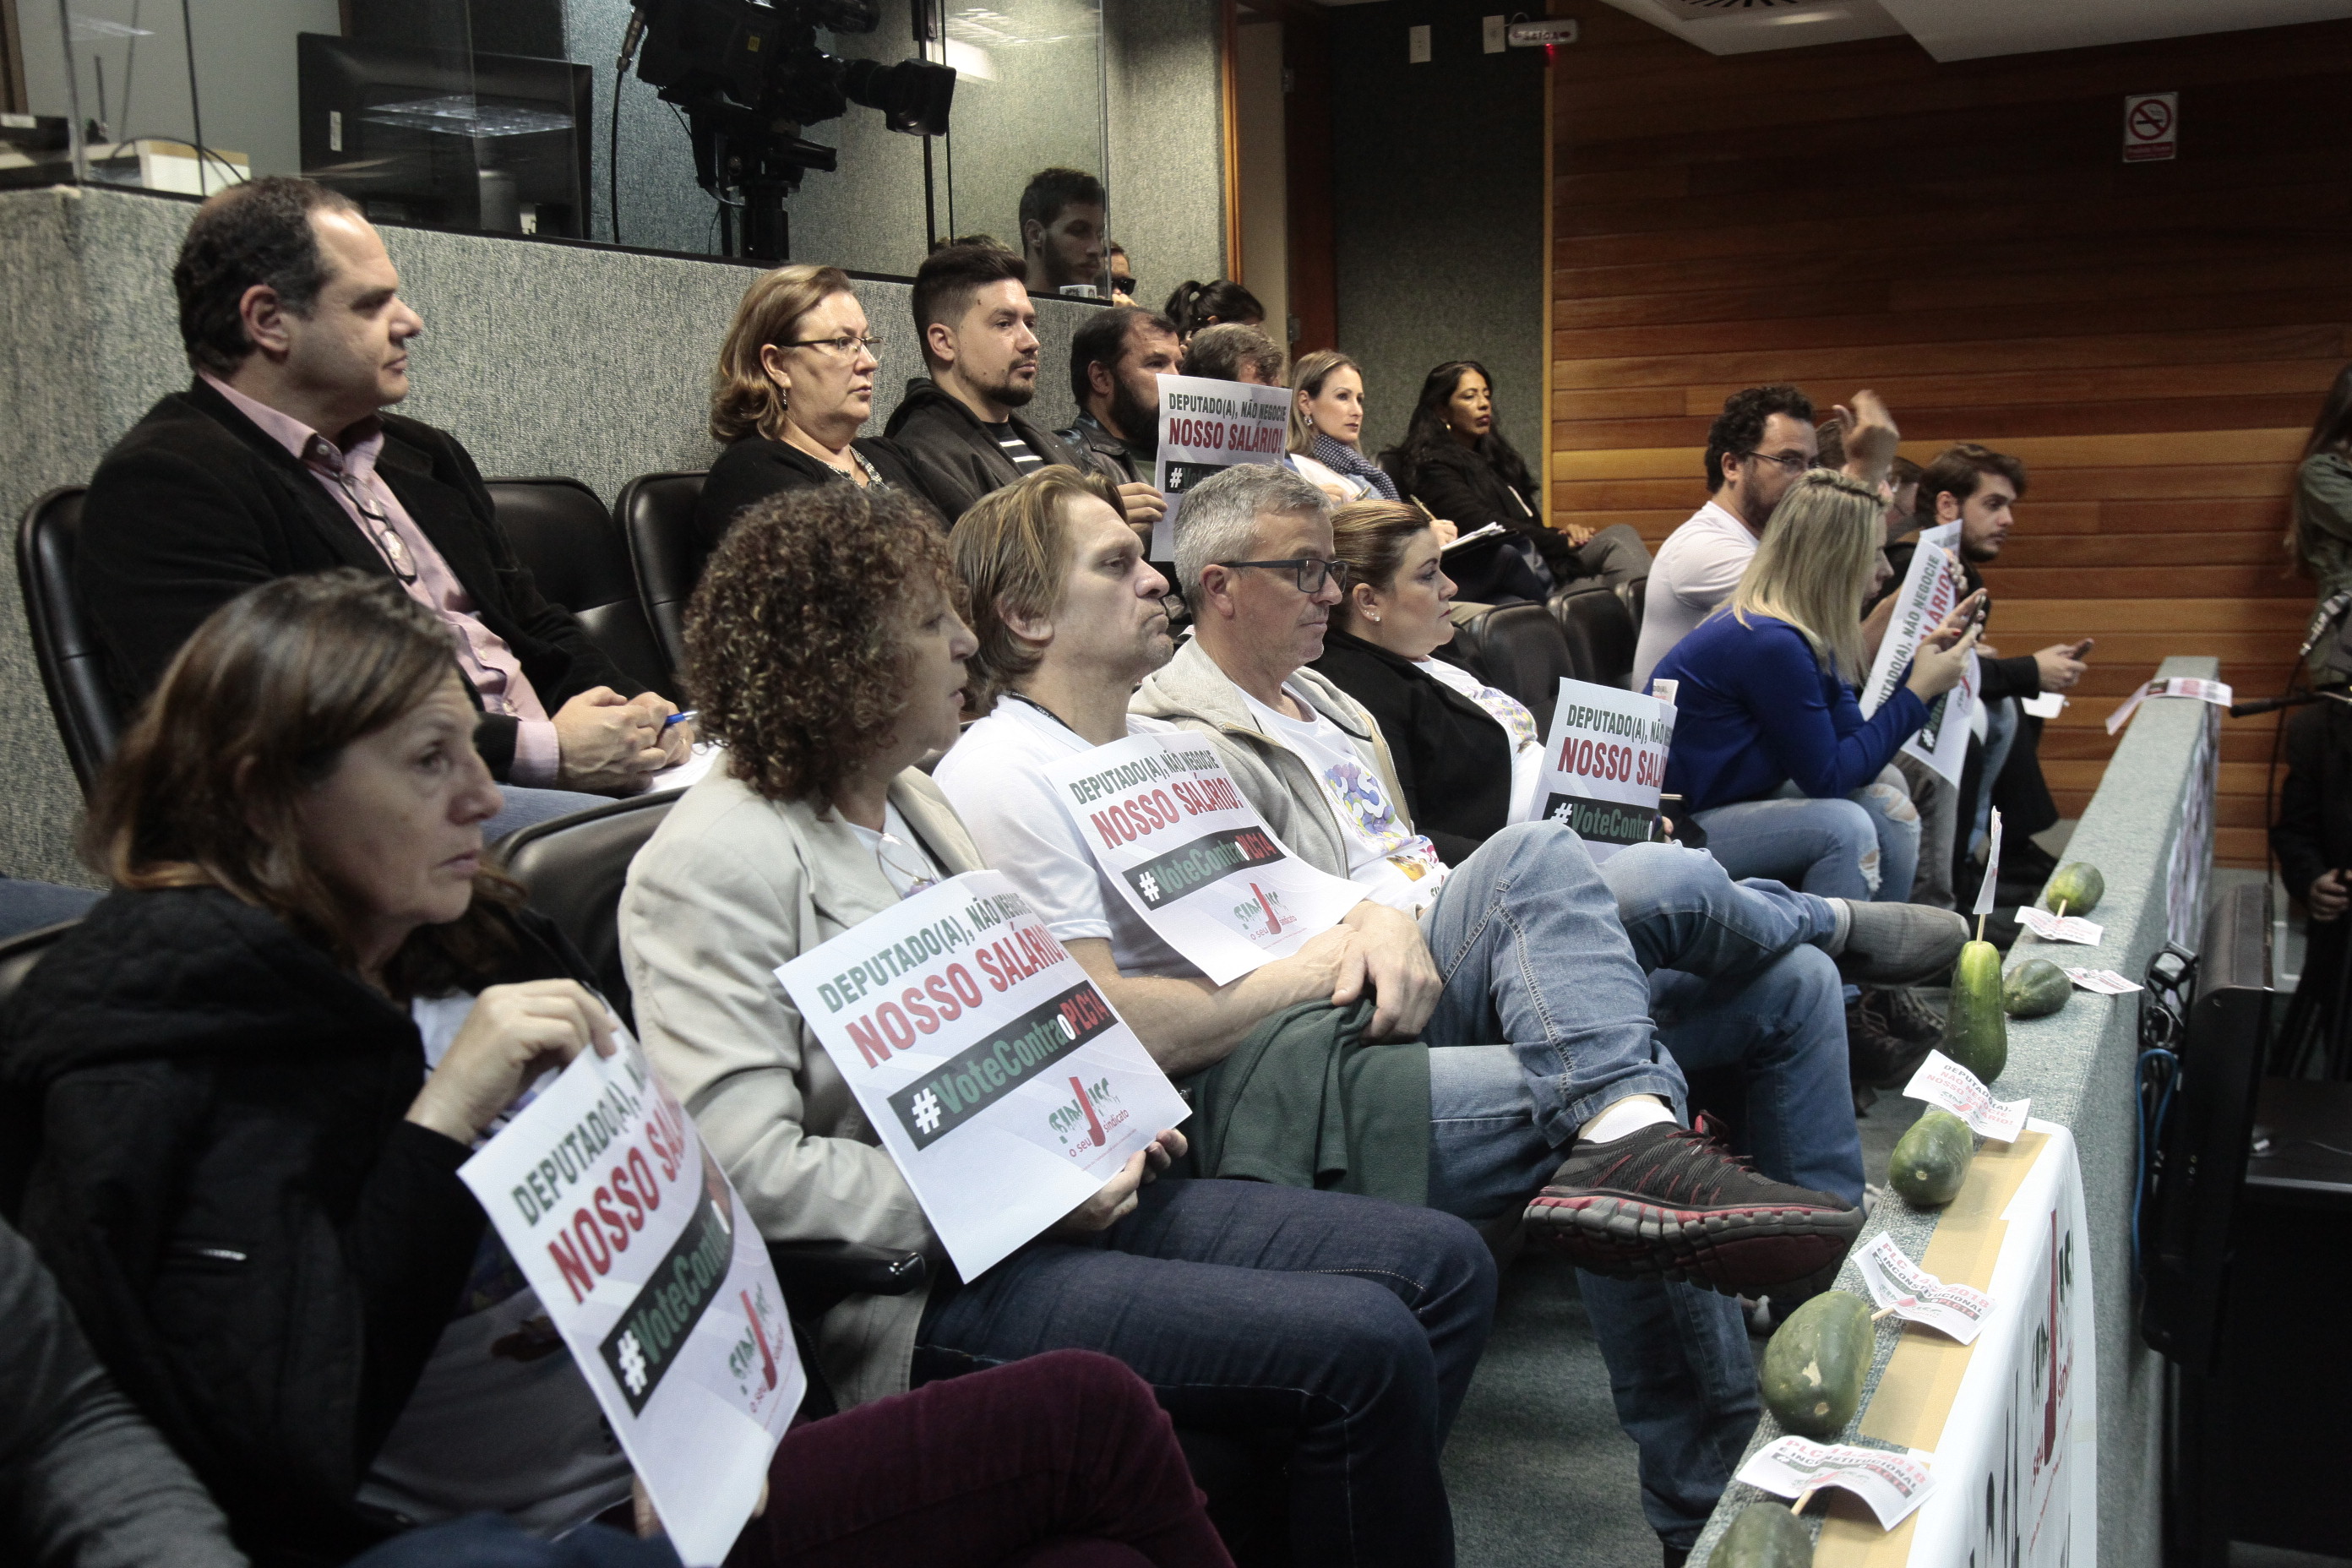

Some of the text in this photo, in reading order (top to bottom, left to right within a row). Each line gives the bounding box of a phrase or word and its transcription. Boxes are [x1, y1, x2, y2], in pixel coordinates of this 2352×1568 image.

[1169, 393, 1287, 422] DEPUTADO(A), NÃO NEGOCIE
[1169, 417, 1283, 455] NOSSO SALÁRIO!
[1903, 611, 1920, 638] NÃO
[1912, 553, 1941, 610] NEGOCIE
[1566, 704, 1647, 744] DEPUTADO(A),
[1650, 718, 1664, 745] NÃO
[1069, 749, 1220, 805] DEPUTADO(A), NÃO NEGOCIE
[1558, 737, 1632, 782] NOSSO
[1090, 772, 1244, 850] NOSSO SALÁRIO!
[1255, 927, 1268, 938] seu
[816, 916, 975, 1013] DEPUTADO(A),
[965, 896, 1002, 933] NÃO
[844, 921, 1069, 1070] NOSSO SALÁRIO!
[1926, 1074, 1965, 1096] NOSSO
[1940, 1071, 1964, 1086] NÃO
[1069, 1108, 1130, 1158] o seu sindicato
[547, 1146, 661, 1305] NOSSO
[1882, 1242, 1908, 1271] PLC
[1784, 1440, 1824, 1458] PLC
